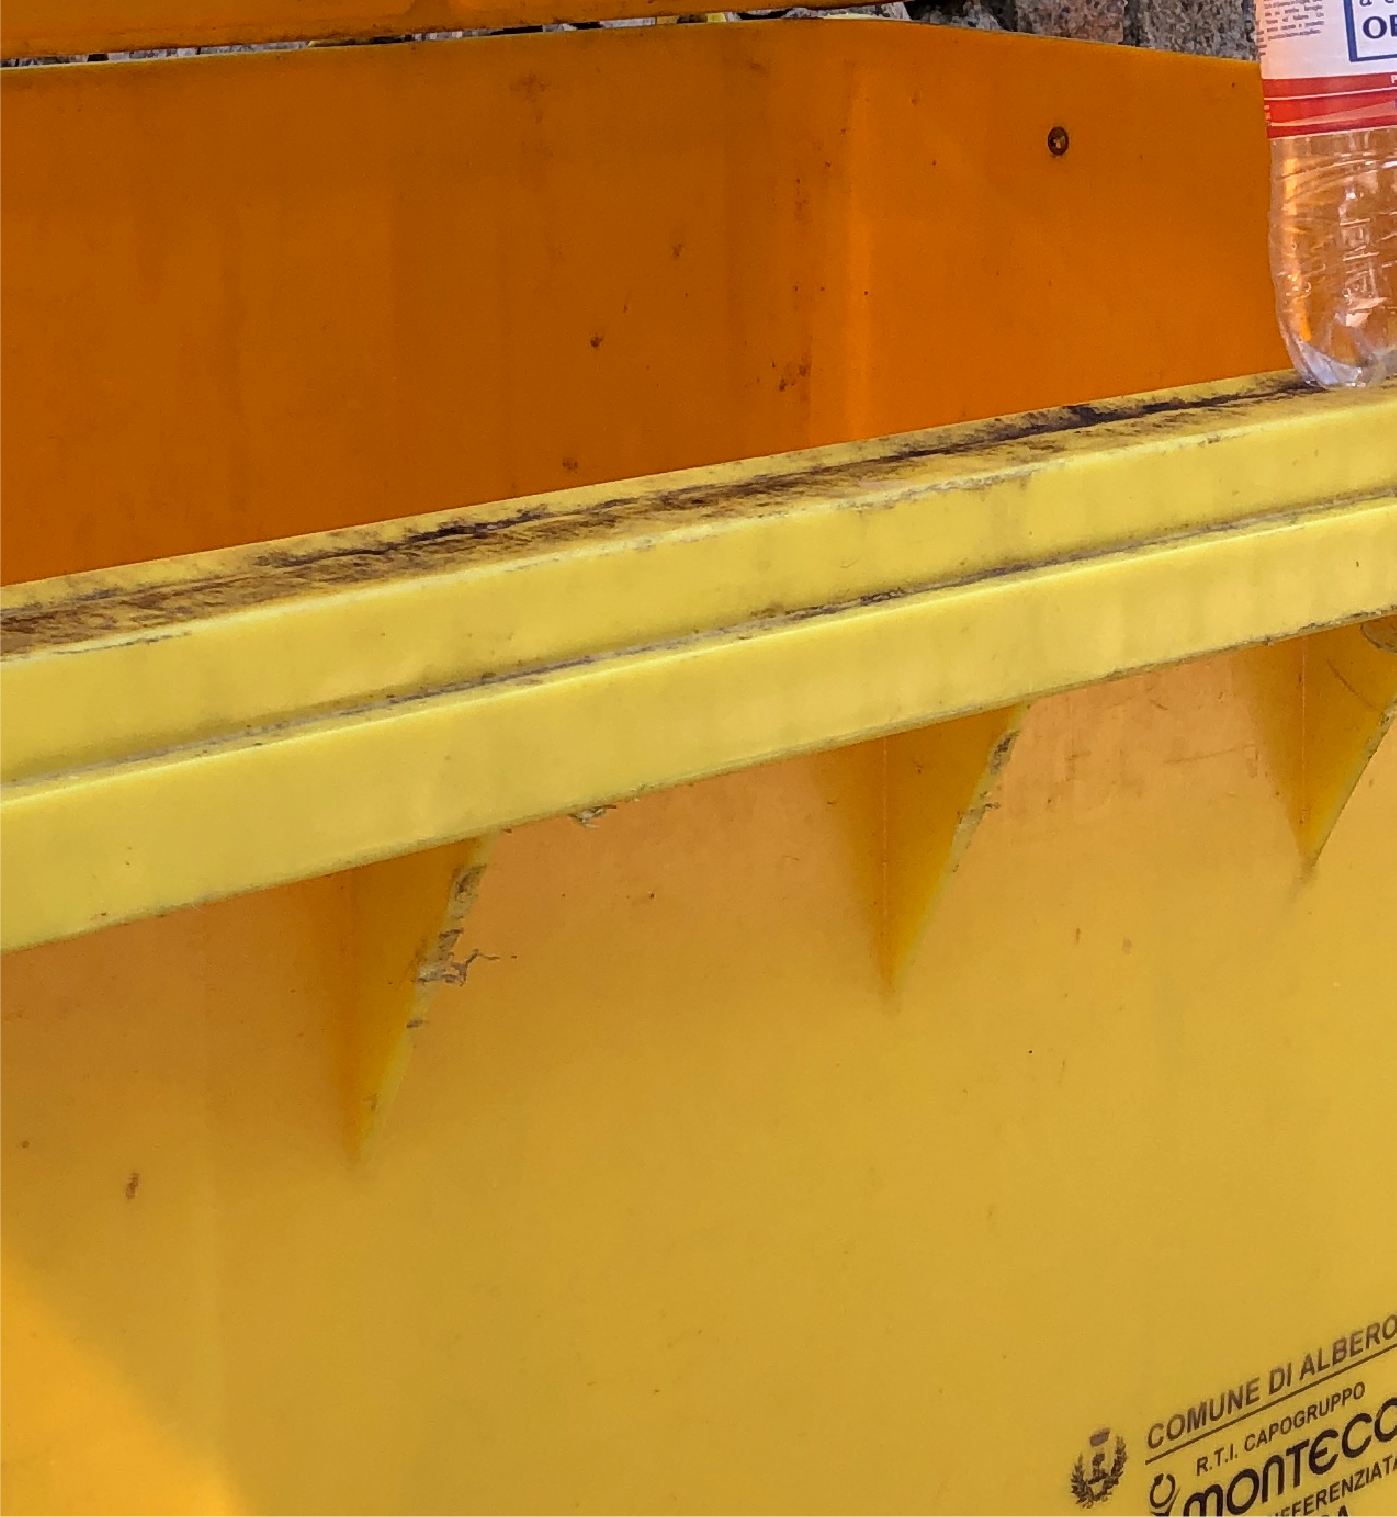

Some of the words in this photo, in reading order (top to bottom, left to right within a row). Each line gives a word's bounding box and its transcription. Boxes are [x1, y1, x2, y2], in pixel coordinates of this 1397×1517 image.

[1148, 1377, 1260, 1450] COMUNE
[1268, 1362, 1291, 1395] DI
[1196, 1443, 1239, 1476] R.T.I.
[1244, 1381, 1366, 1453] CAPOGRUPPO
